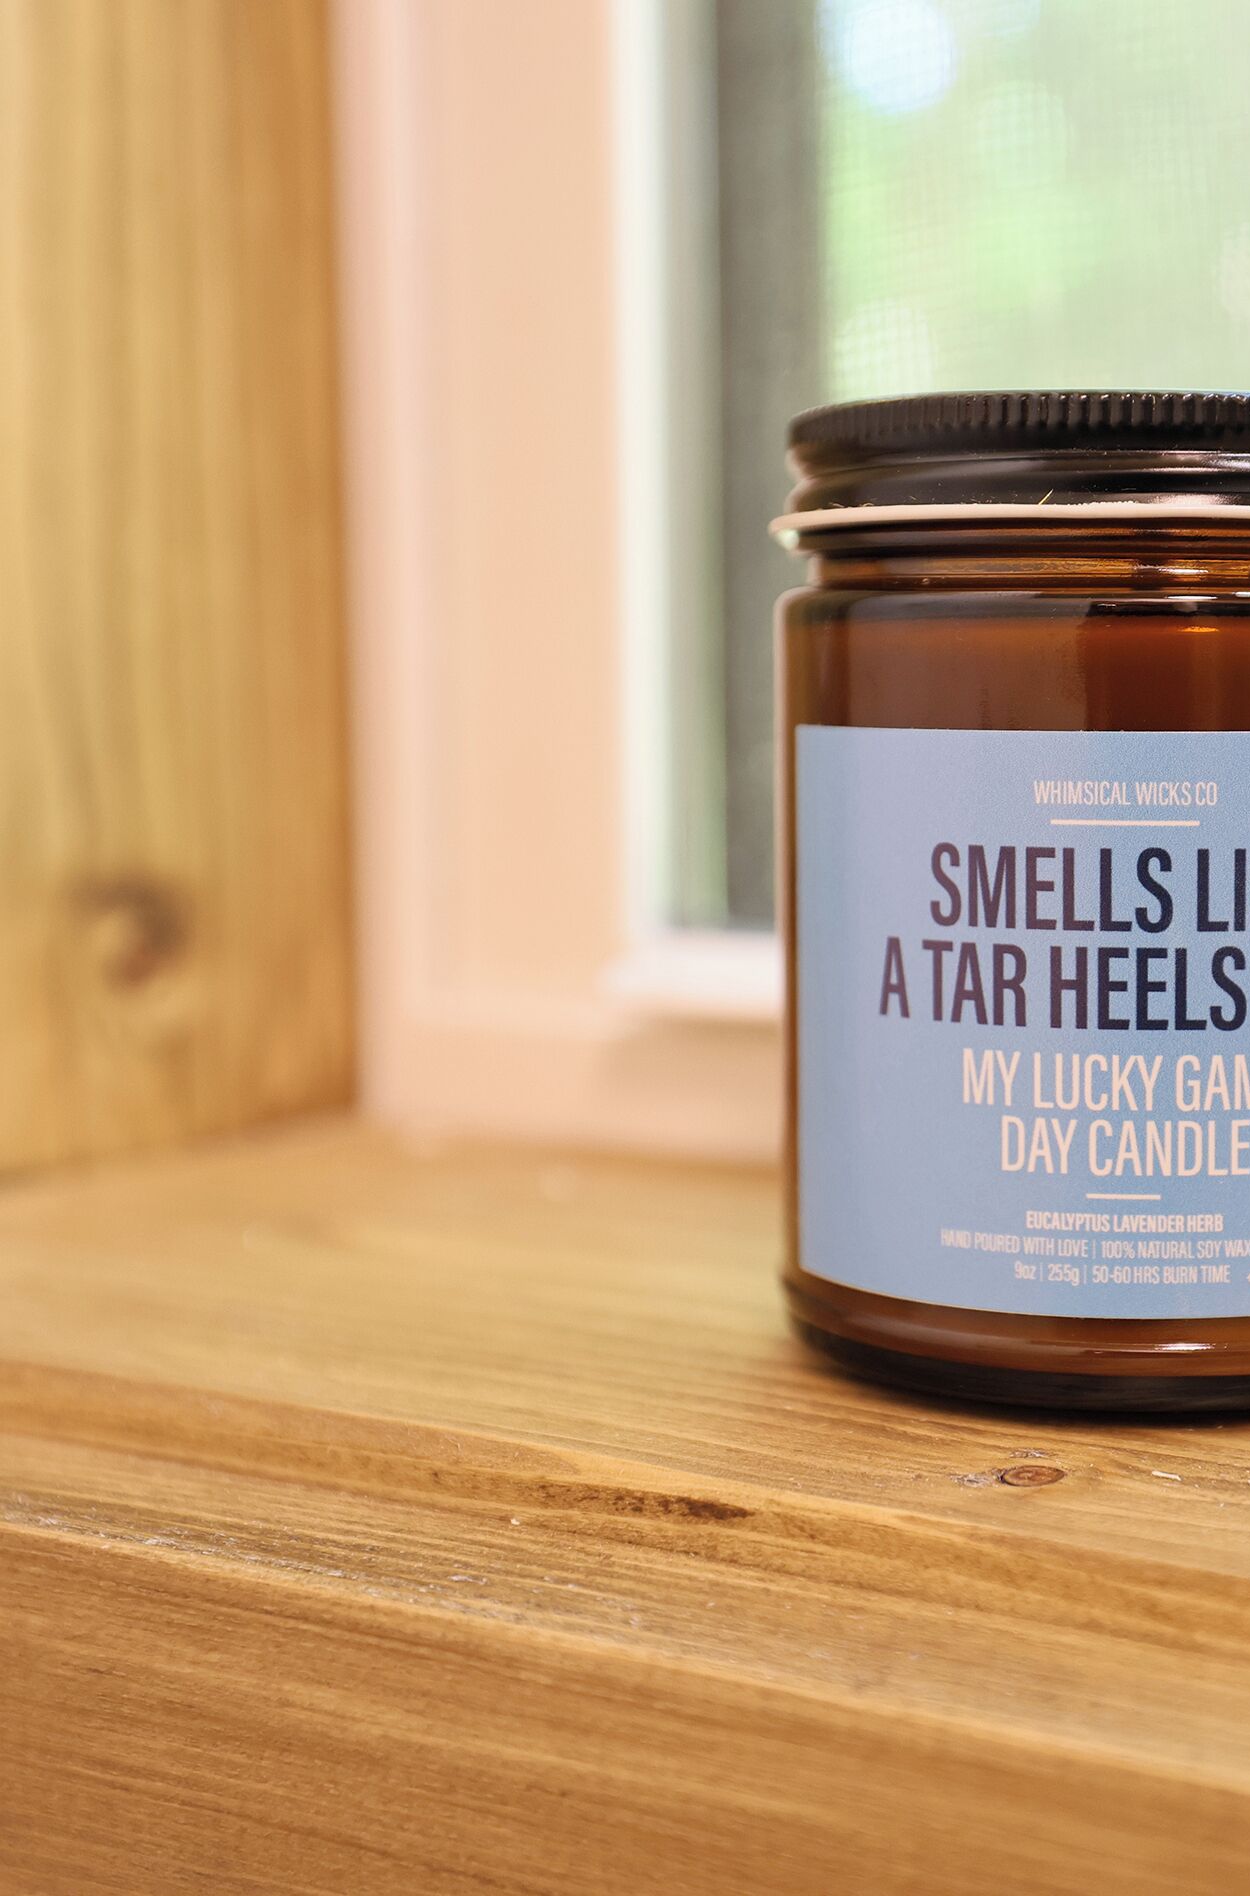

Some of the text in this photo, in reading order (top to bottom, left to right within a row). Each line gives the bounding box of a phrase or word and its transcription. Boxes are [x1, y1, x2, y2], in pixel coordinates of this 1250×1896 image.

[1034, 780, 1218, 806] WHIMSICAL WICKS CO
[931, 842, 1173, 933] SMELLS
[879, 937, 910, 1018] A
[922, 939, 1027, 1030] TAR
[1051, 946, 1247, 1030] HEELS
[963, 1048, 1021, 1105] MY
[1033, 1052, 1163, 1111] LUCKY
[1001, 1115, 1250, 1177] DAY CANDLE
[941, 1228, 971, 1248] HAND
[974, 1233, 1020, 1253] POURED
[1023, 1236, 1054, 1256] WITH
[1058, 1238, 1089, 1258] LOVE
[1101, 1239, 1135, 1259] 100%
[1138, 1240, 1194, 1259] NATURAL
[1197, 1240, 1221, 1259] SOY
[1026, 1211, 1224, 1233] EUCALYPTUS LAVENDER HERB
[1015, 1261, 1036, 1280] 9oz
[1048, 1263, 1080, 1286] 255g
[1092, 1265, 1131, 1284] 50-60
[1134, 1265, 1160, 1284] HRS
[1163, 1265, 1198, 1284] BURN
[1201, 1264, 1230, 1283] TIME
